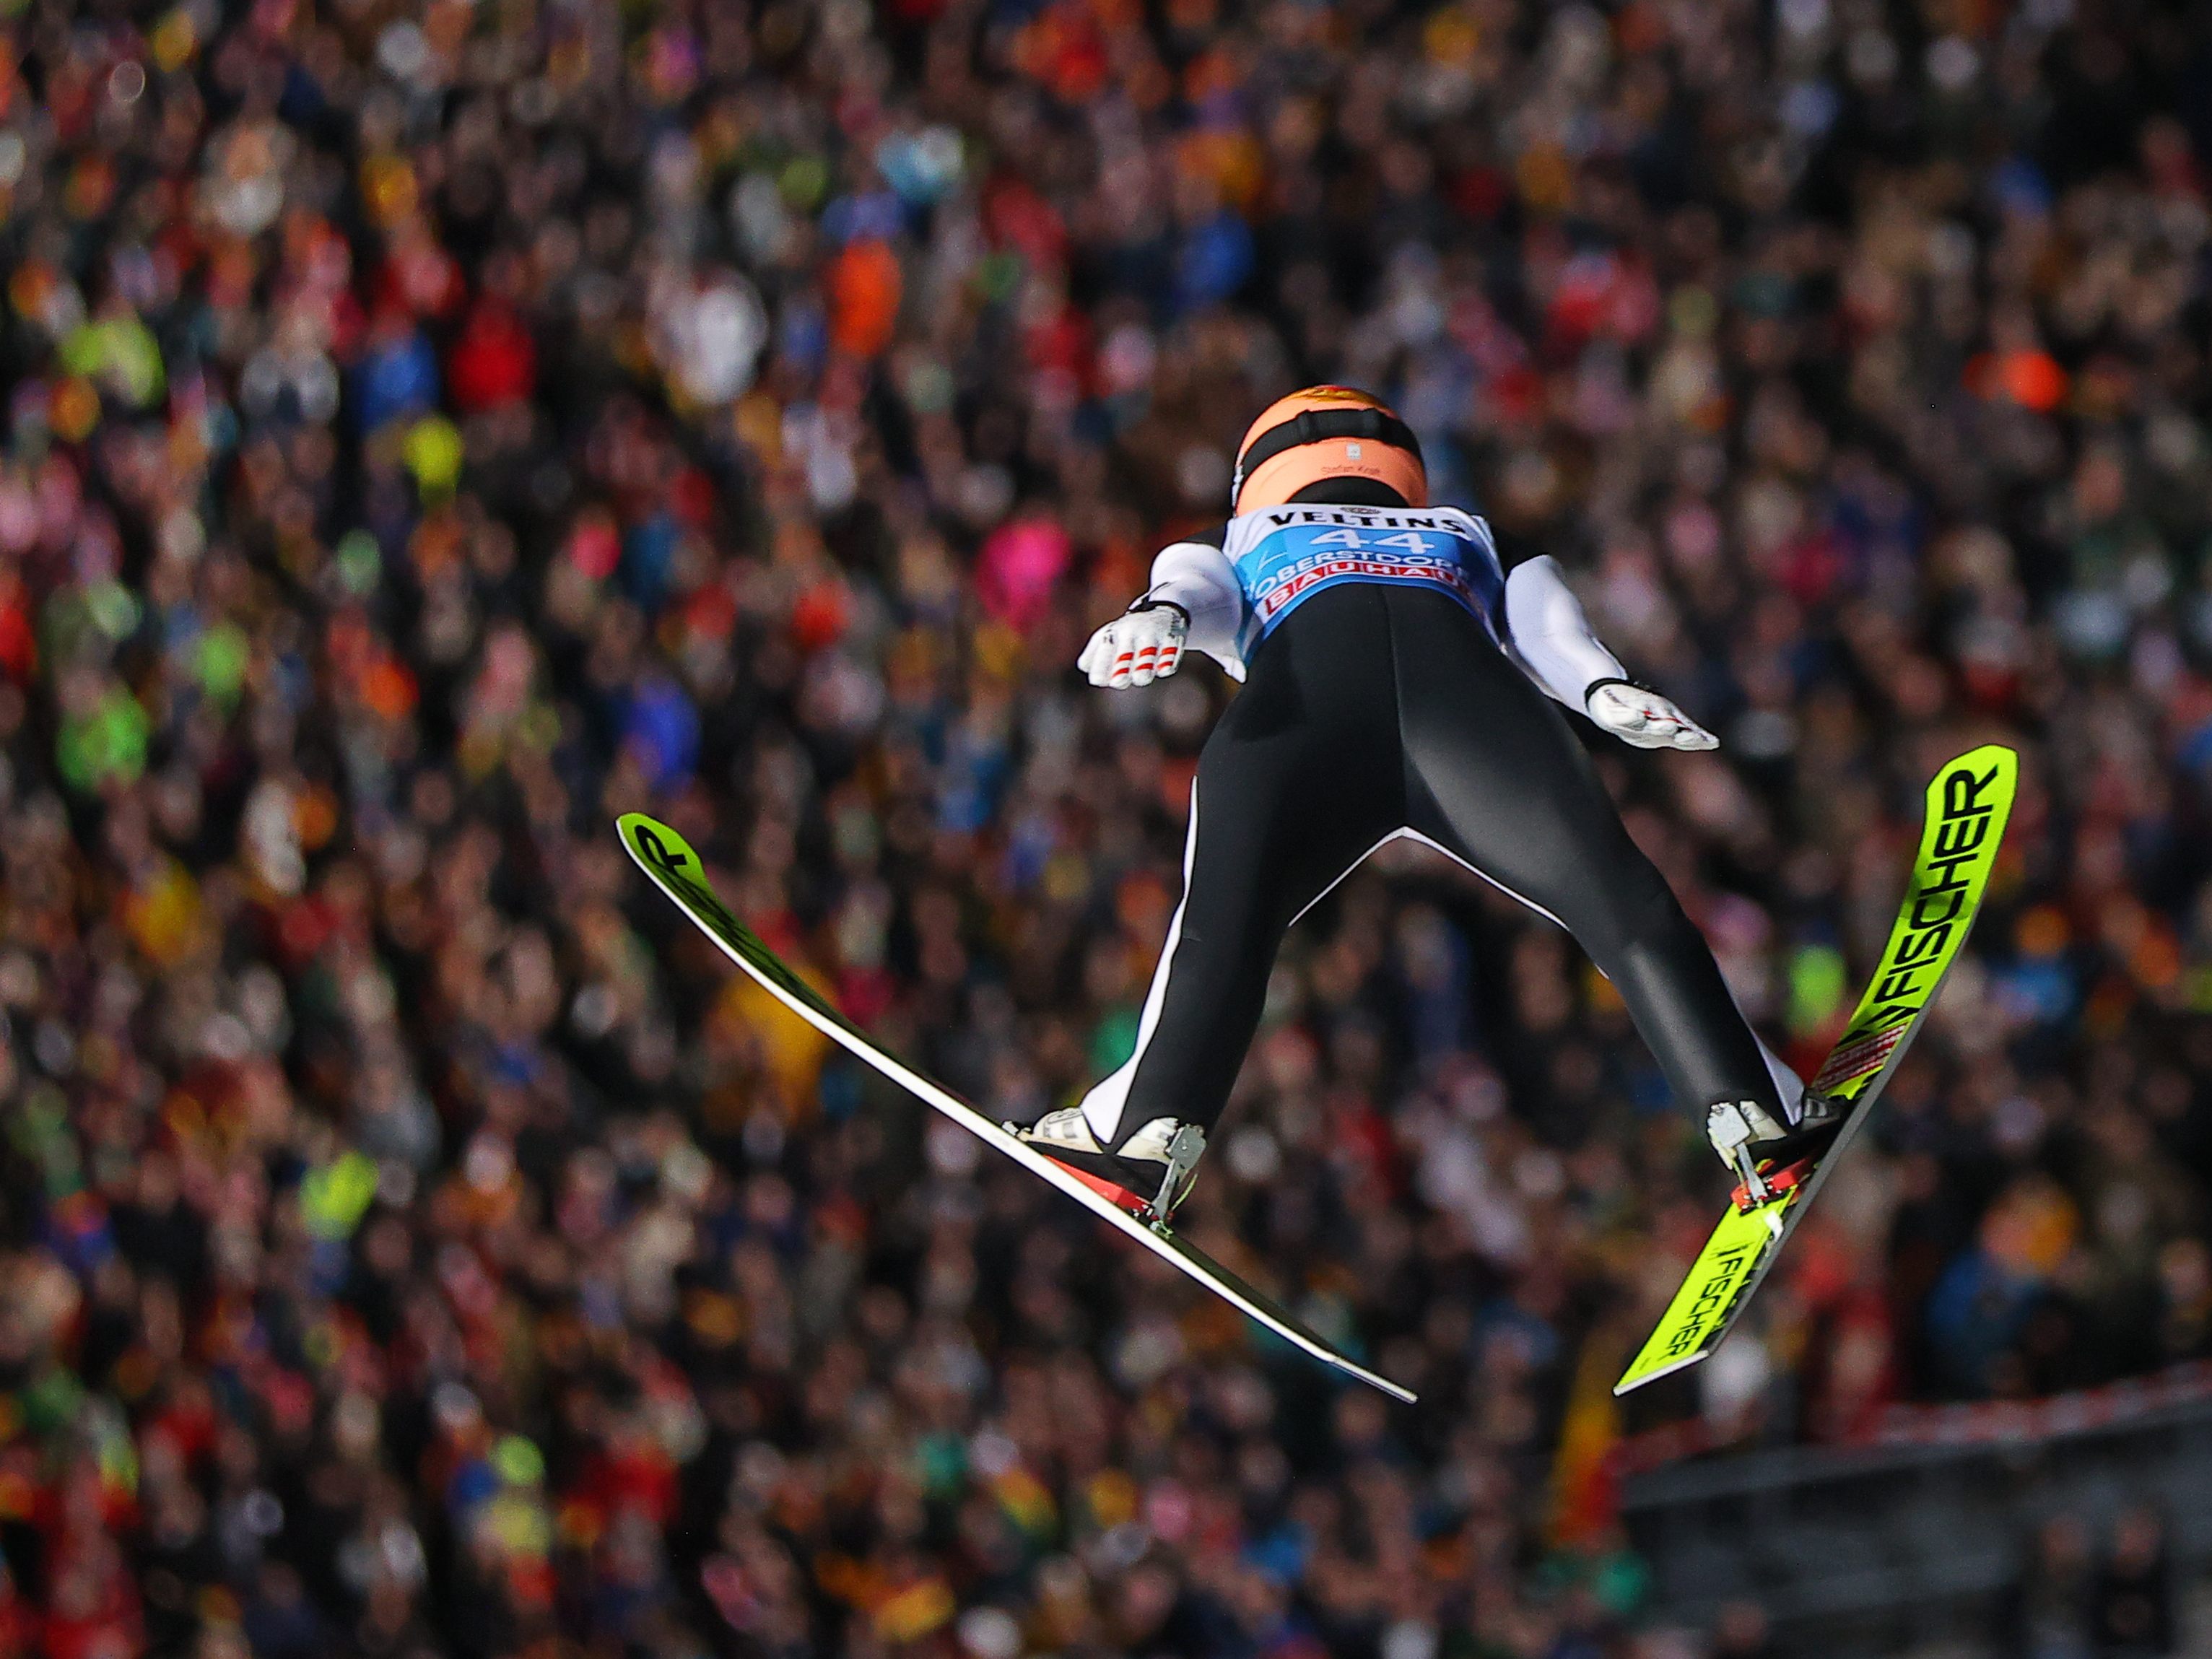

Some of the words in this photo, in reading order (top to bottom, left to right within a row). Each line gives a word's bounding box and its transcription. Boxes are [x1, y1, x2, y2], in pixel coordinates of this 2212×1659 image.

[1268, 511, 1466, 534] VELTINS
[1310, 528, 1435, 554] 44
[1268, 561, 1468, 611] BAUHAU
[1873, 764, 1998, 1004] FISCHER
[1658, 1256, 1740, 1362] FISCHER
